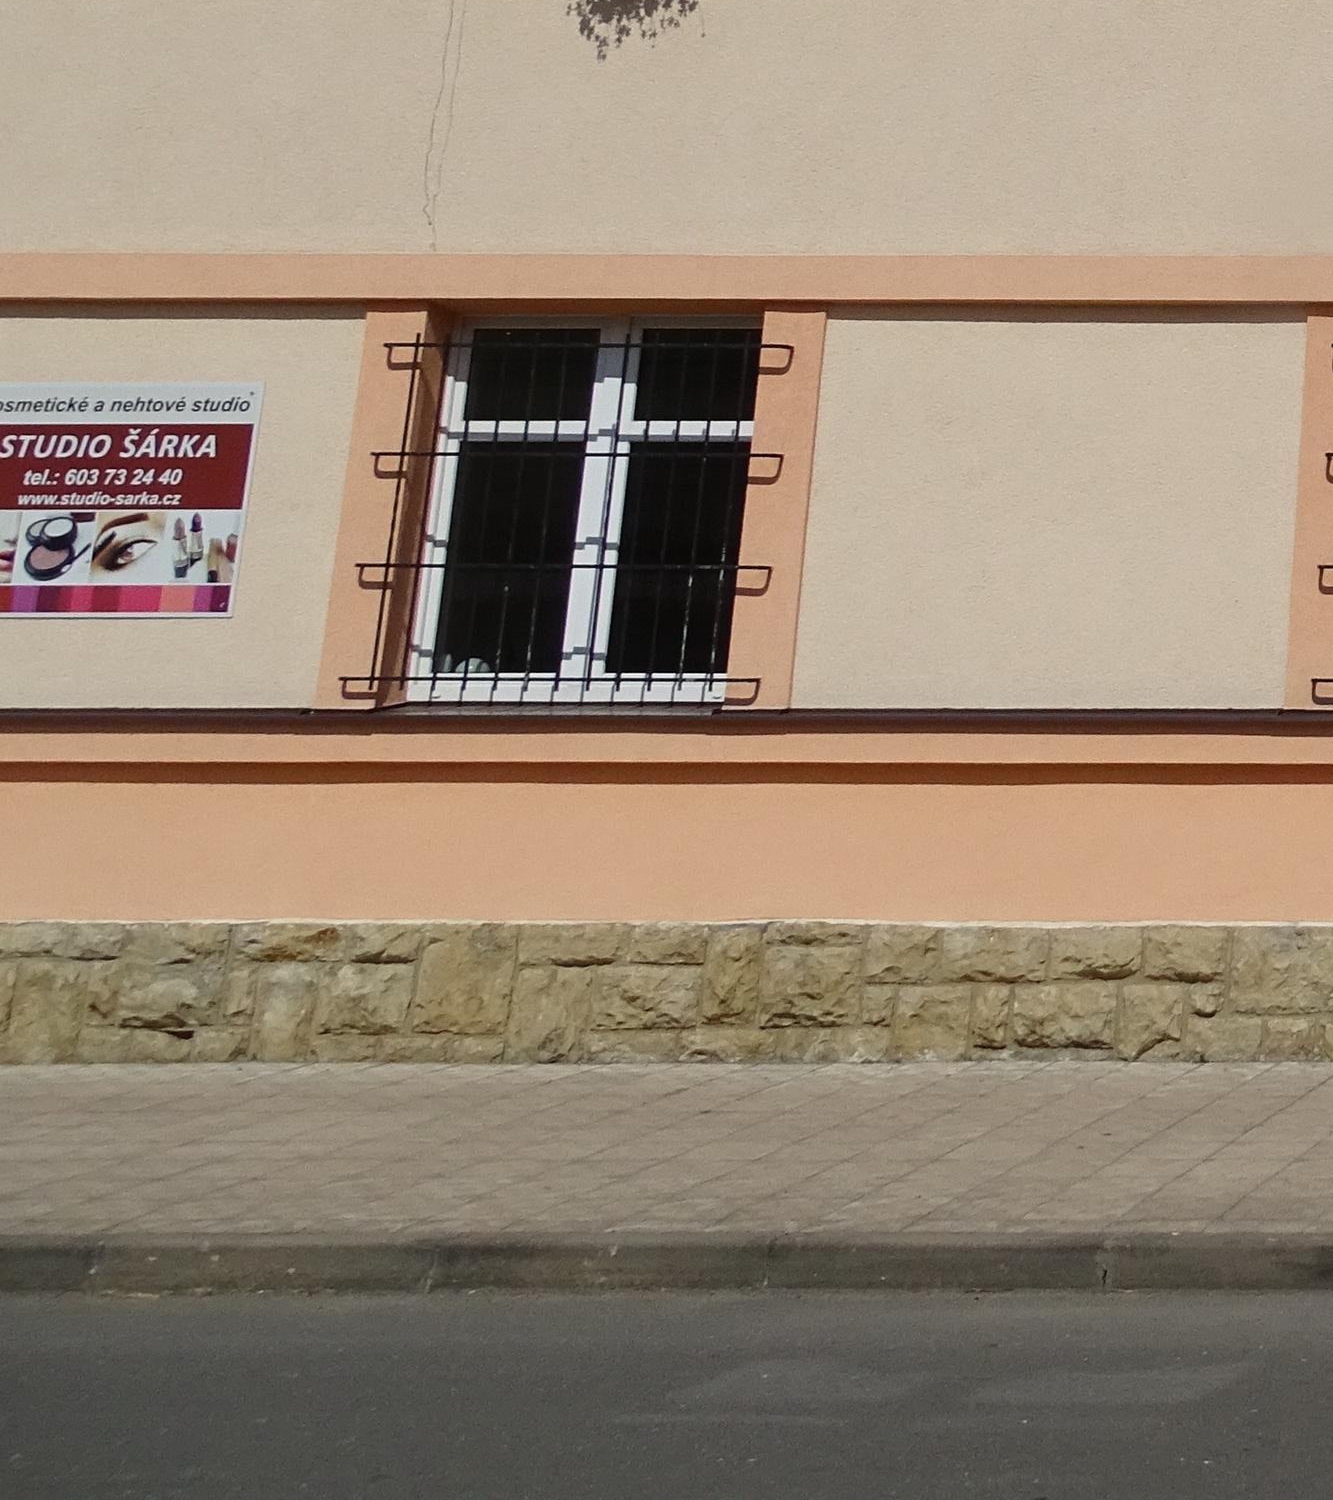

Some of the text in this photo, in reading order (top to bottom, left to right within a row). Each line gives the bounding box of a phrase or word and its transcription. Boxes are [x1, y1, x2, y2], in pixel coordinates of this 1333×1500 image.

[94, 400, 104, 412] a
[110, 396, 187, 412] nehtové
[191, 396, 250, 412] studio
[0, 428, 217, 458] STUDIO ŠÁRKA
[23, 468, 183, 486] tel.: 603 73 24 40
[17, 491, 182, 506] www.studio-sarka.cz
